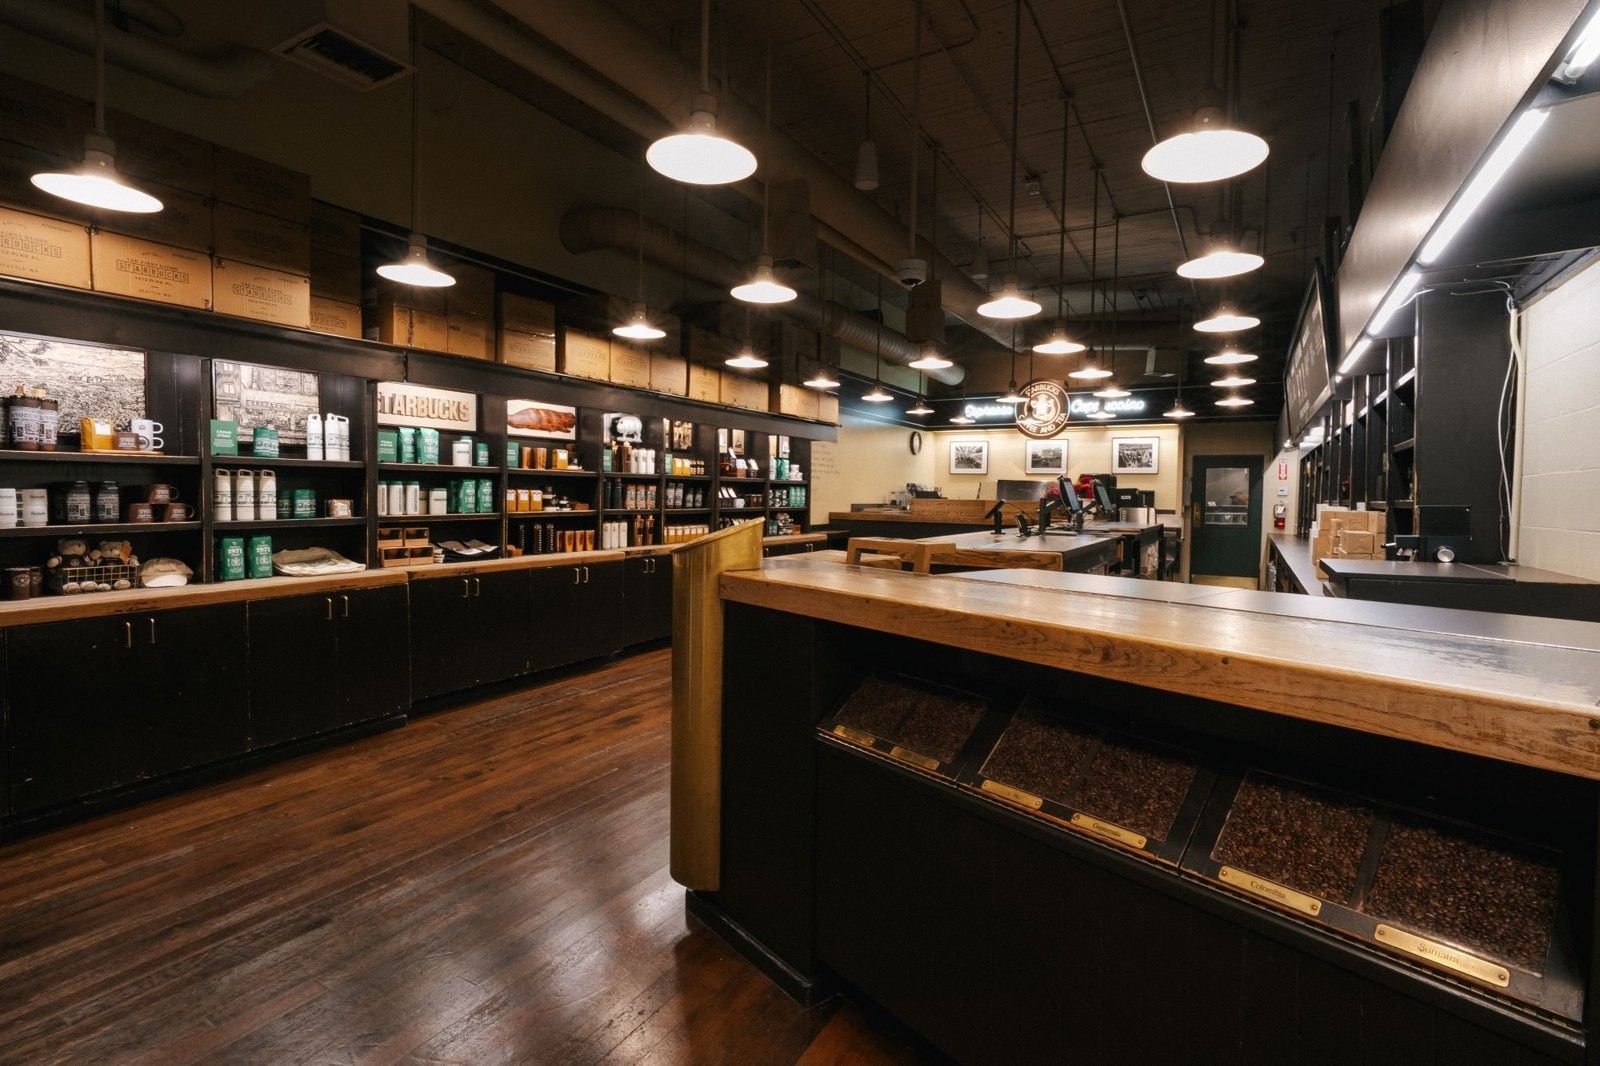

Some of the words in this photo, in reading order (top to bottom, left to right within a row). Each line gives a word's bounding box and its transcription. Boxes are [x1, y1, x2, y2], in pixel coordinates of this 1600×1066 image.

[0, 234, 62, 258] RBUCKS
[117, 260, 189, 283] STARBUCKS
[1025, 384, 1061, 397] SARBUCKS
[1040, 423, 1056, 434] AND
[1249, 880, 1287, 900] Colombia
[1417, 942, 1460, 965] Sumatra
